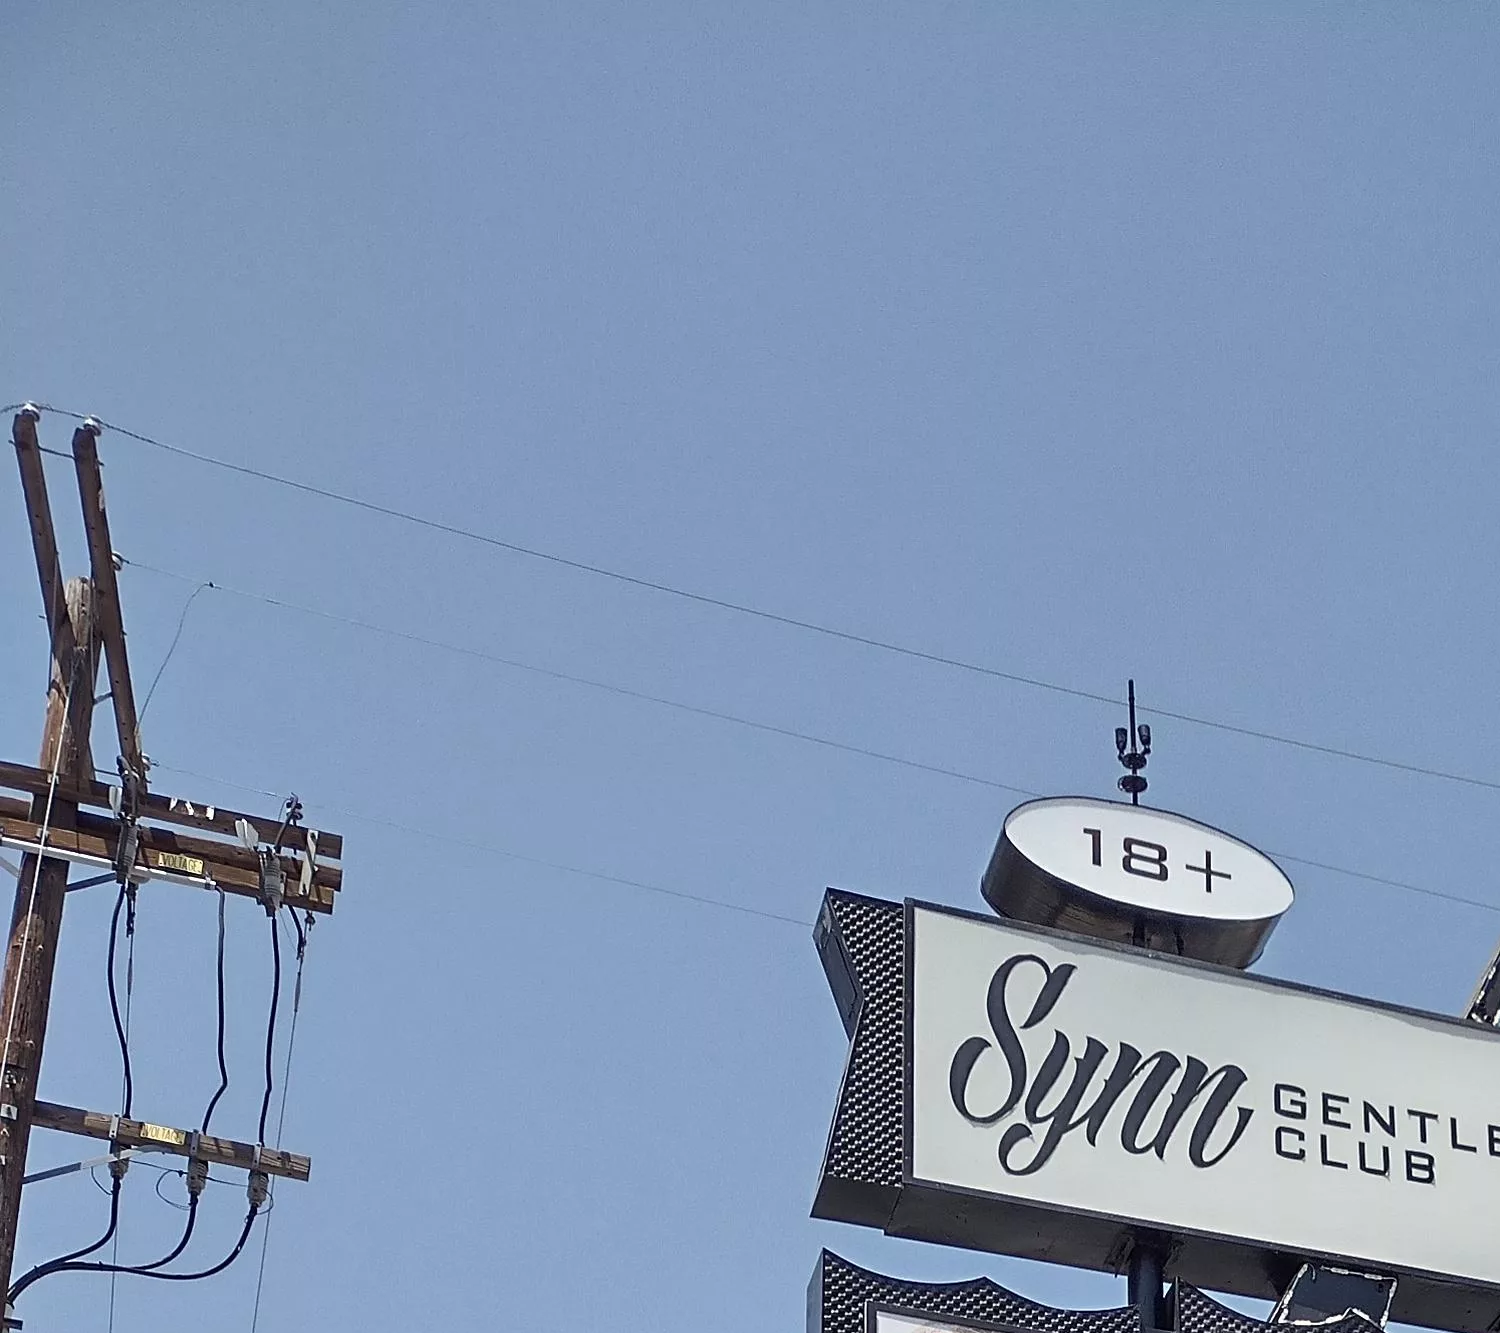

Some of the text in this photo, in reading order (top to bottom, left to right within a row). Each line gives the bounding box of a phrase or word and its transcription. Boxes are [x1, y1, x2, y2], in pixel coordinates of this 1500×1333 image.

[1081, 825, 1233, 895] 18+
[948, 953, 1254, 1178] Synn
[1274, 1125, 1438, 1187] CLUB
